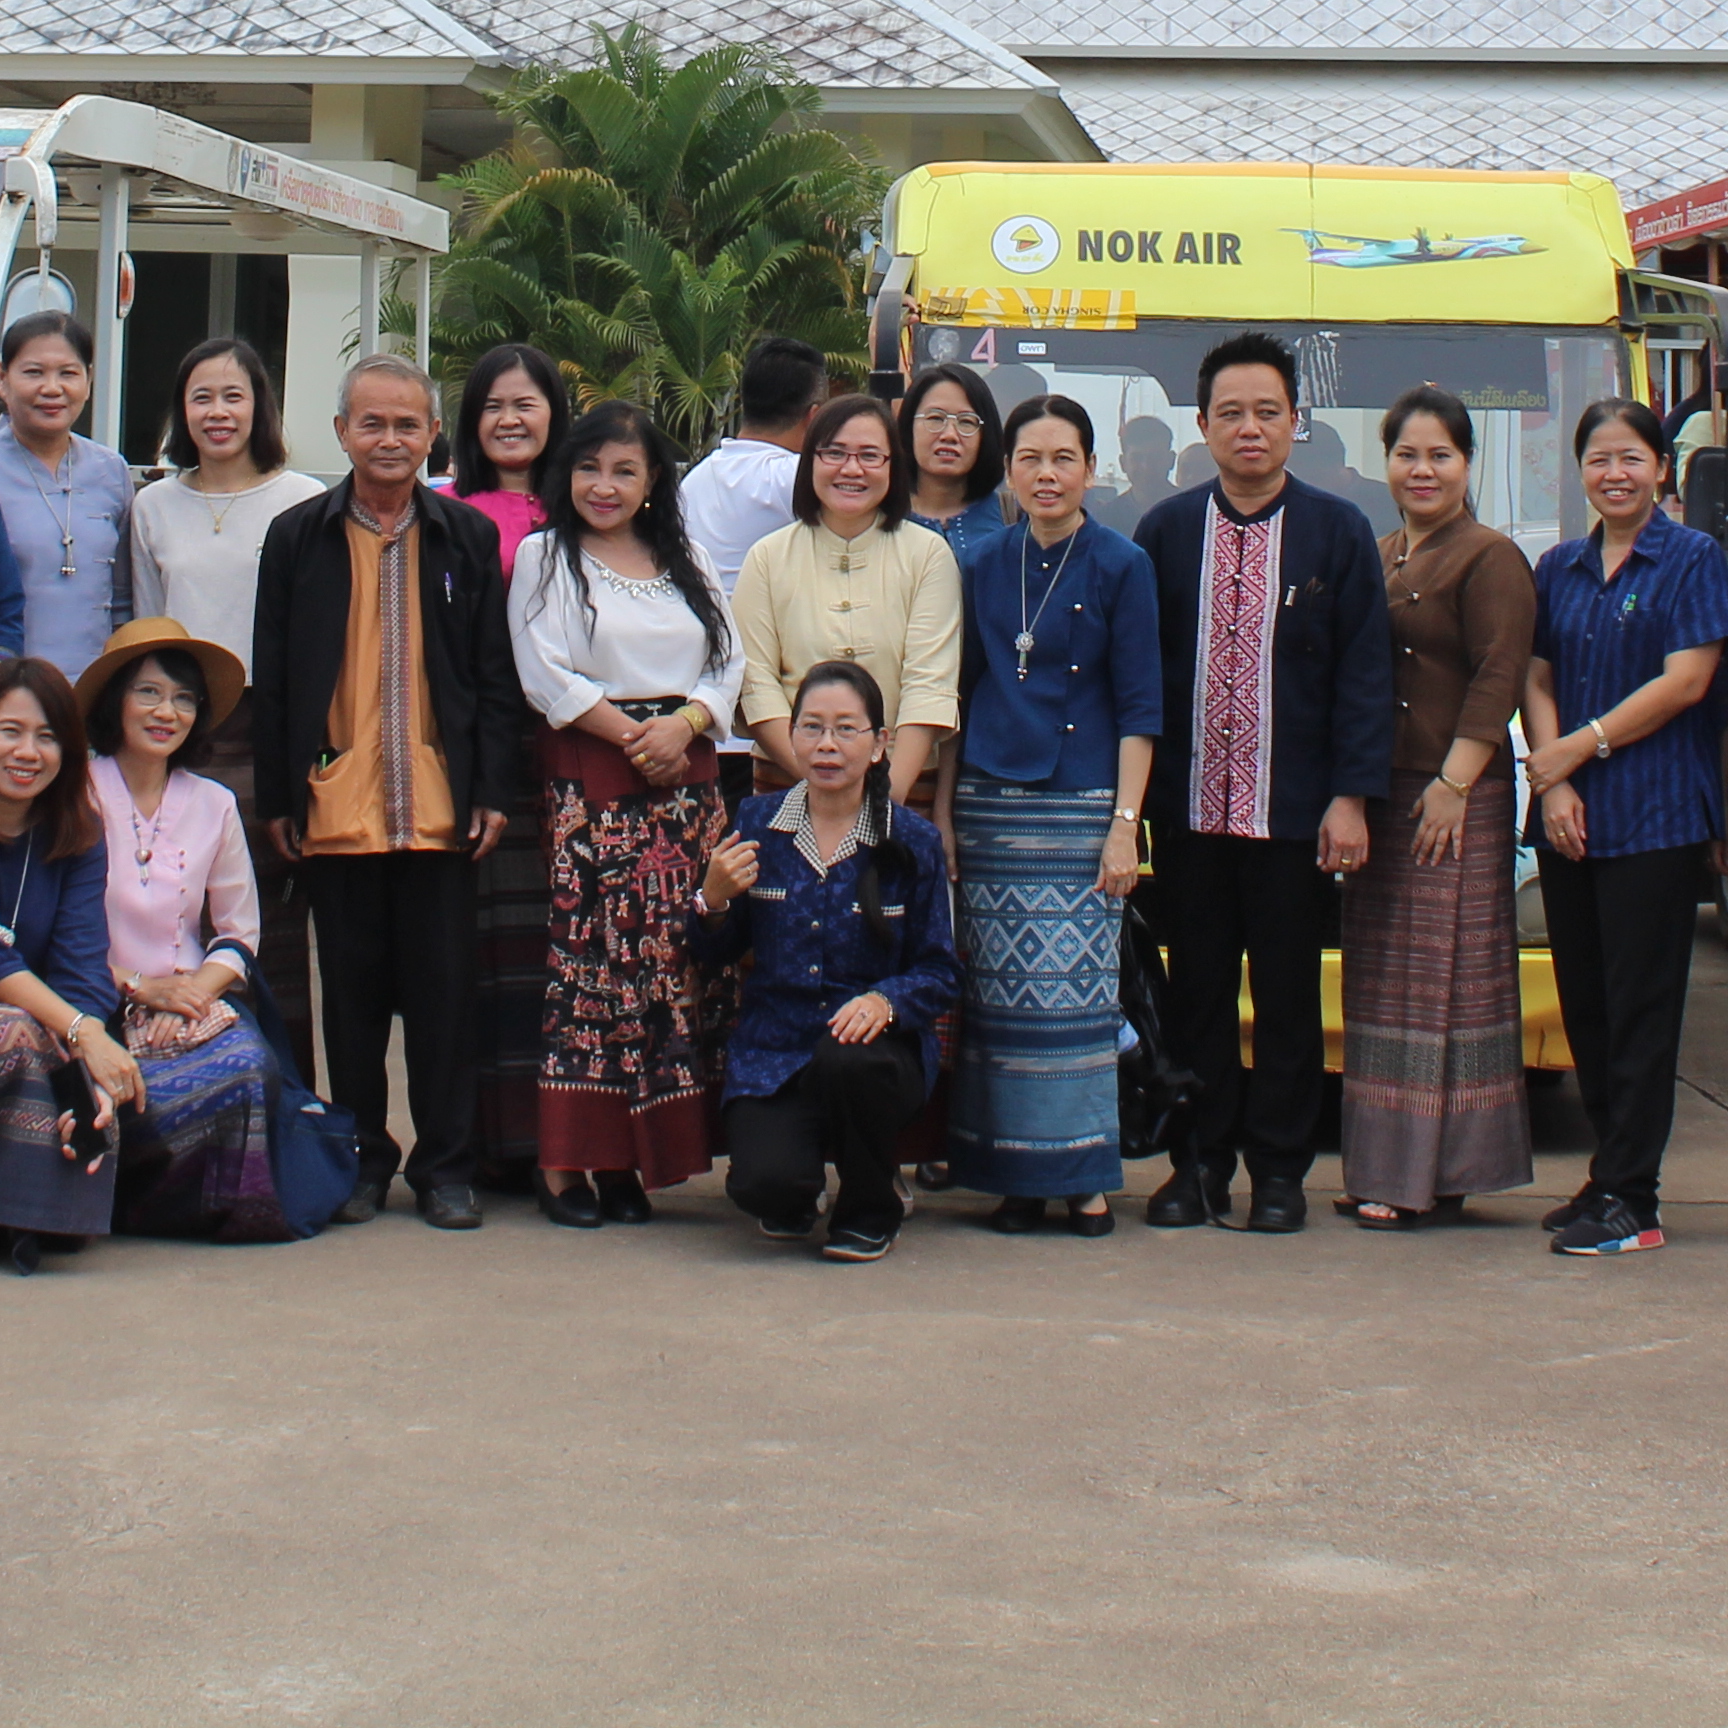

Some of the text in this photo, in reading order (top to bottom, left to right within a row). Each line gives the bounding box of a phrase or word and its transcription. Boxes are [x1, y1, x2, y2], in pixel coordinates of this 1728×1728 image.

[1078, 229, 1242, 265] NOK AIR
[1049, 306, 1102, 316] SINGHA
[971, 328, 998, 369] 4
